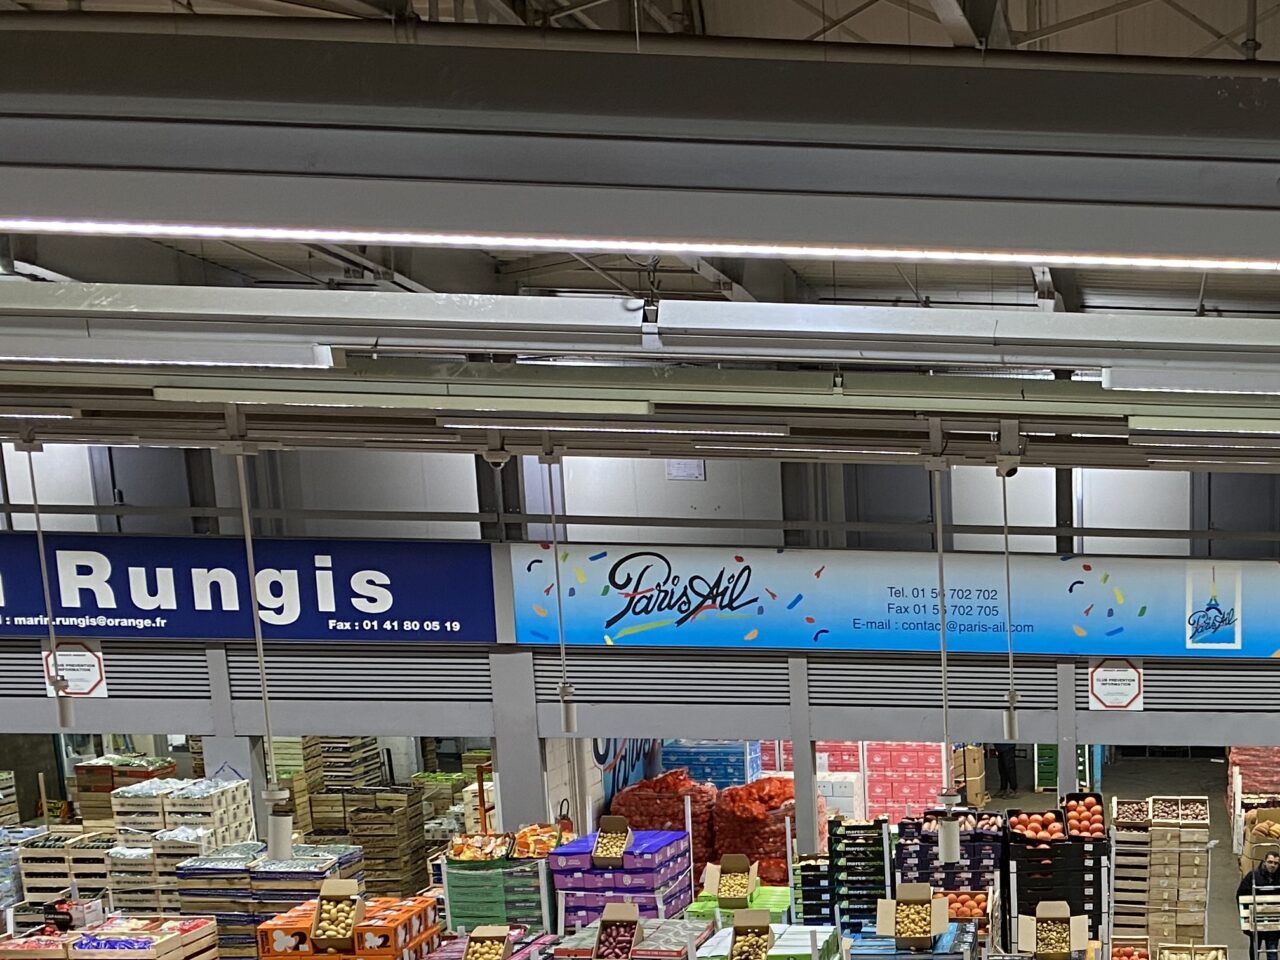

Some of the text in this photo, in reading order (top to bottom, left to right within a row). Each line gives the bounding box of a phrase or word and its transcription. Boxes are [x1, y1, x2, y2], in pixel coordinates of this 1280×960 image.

[55, 549, 394, 626] Rungis
[603, 551, 760, 629] Paris Ail
[887, 586, 908, 599] Tel.
[912, 587, 926, 599] 01
[950, 589, 972, 600] 702
[976, 589, 998, 601] 702
[887, 603, 909, 615] Fax
[913, 604, 927, 615] 01
[951, 605, 973, 616] 702
[977, 605, 999, 617] 705
[328, 619, 351, 630] Fax
[363, 620, 378, 630] 01
[383, 620, 399, 630] 41
[403, 620, 420, 631] 80
[424, 621, 440, 631] 05
[445, 621, 460, 631] 19
[852, 618, 891, 630] E-mail
[901, 619, 1034, 634] contac@paris-ail.com
[291, 931, 307, 950] 2
[378, 934, 391, 948] 2
